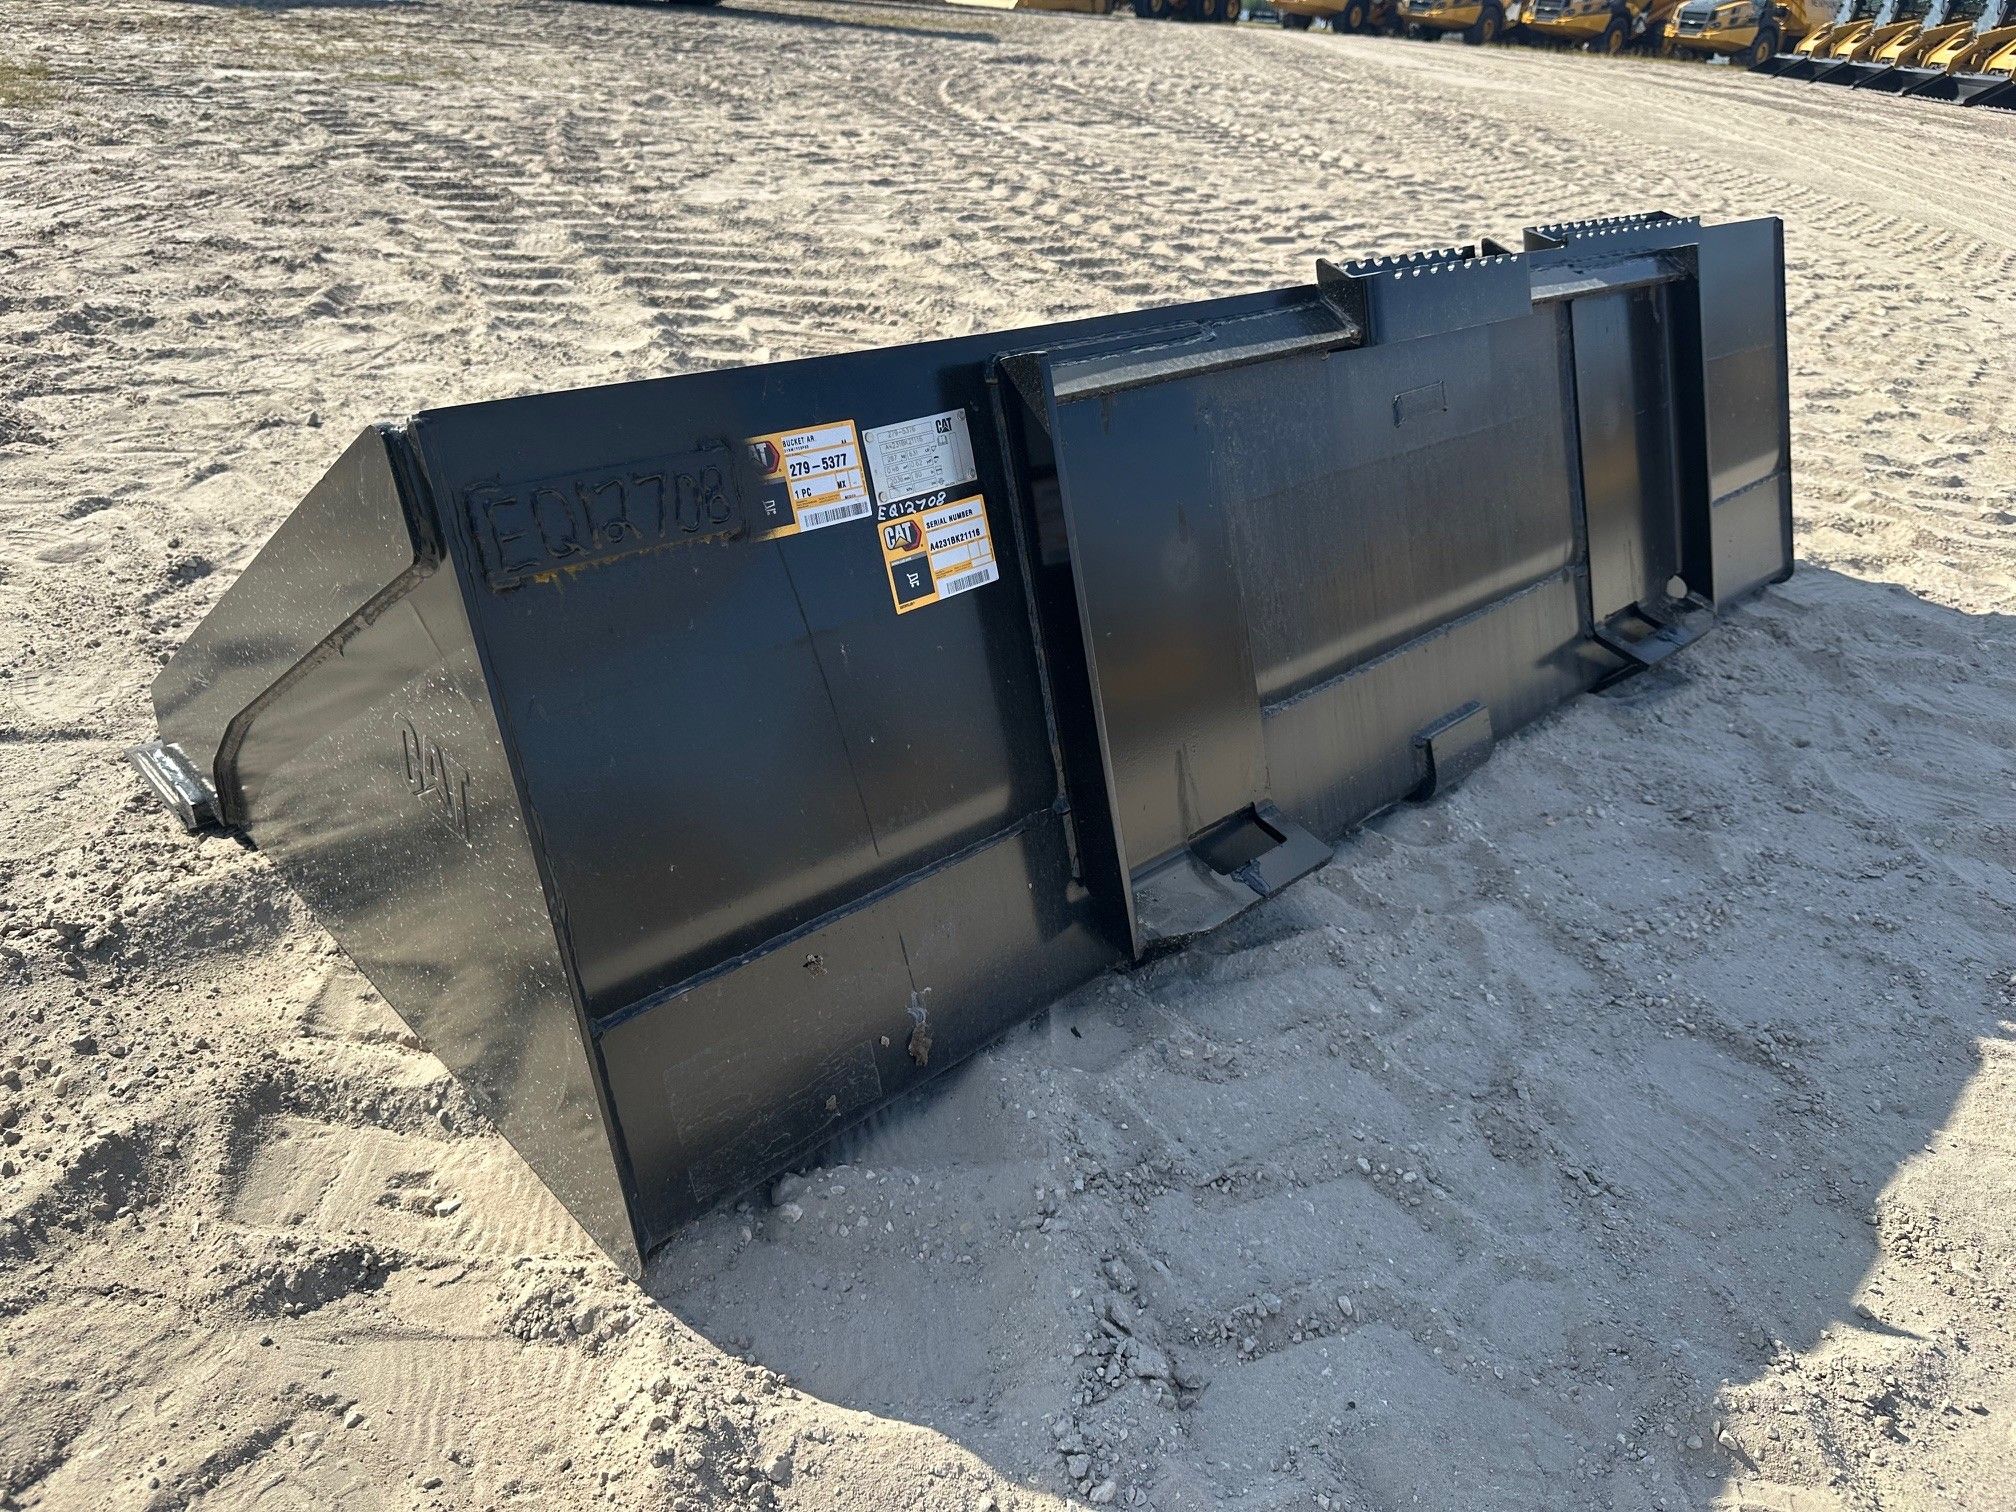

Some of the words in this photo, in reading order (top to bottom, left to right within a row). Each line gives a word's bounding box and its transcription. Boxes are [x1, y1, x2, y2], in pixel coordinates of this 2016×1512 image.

[935, 417, 952, 433] CAT
[782, 437, 804, 448] BUCKET
[806, 434, 815, 443] AR
[795, 491, 799, 499] 1
[802, 487, 812, 497] PC
[837, 481, 847, 490] MX
[878, 492, 946, 521] EQ12708
[926, 518, 947, 529] SERIAL
[948, 509, 973, 522] NUMBER
[884, 521, 912, 549] CAT
[930, 528, 981, 551] A4231BK21116
[394, 712, 472, 848] CAT
